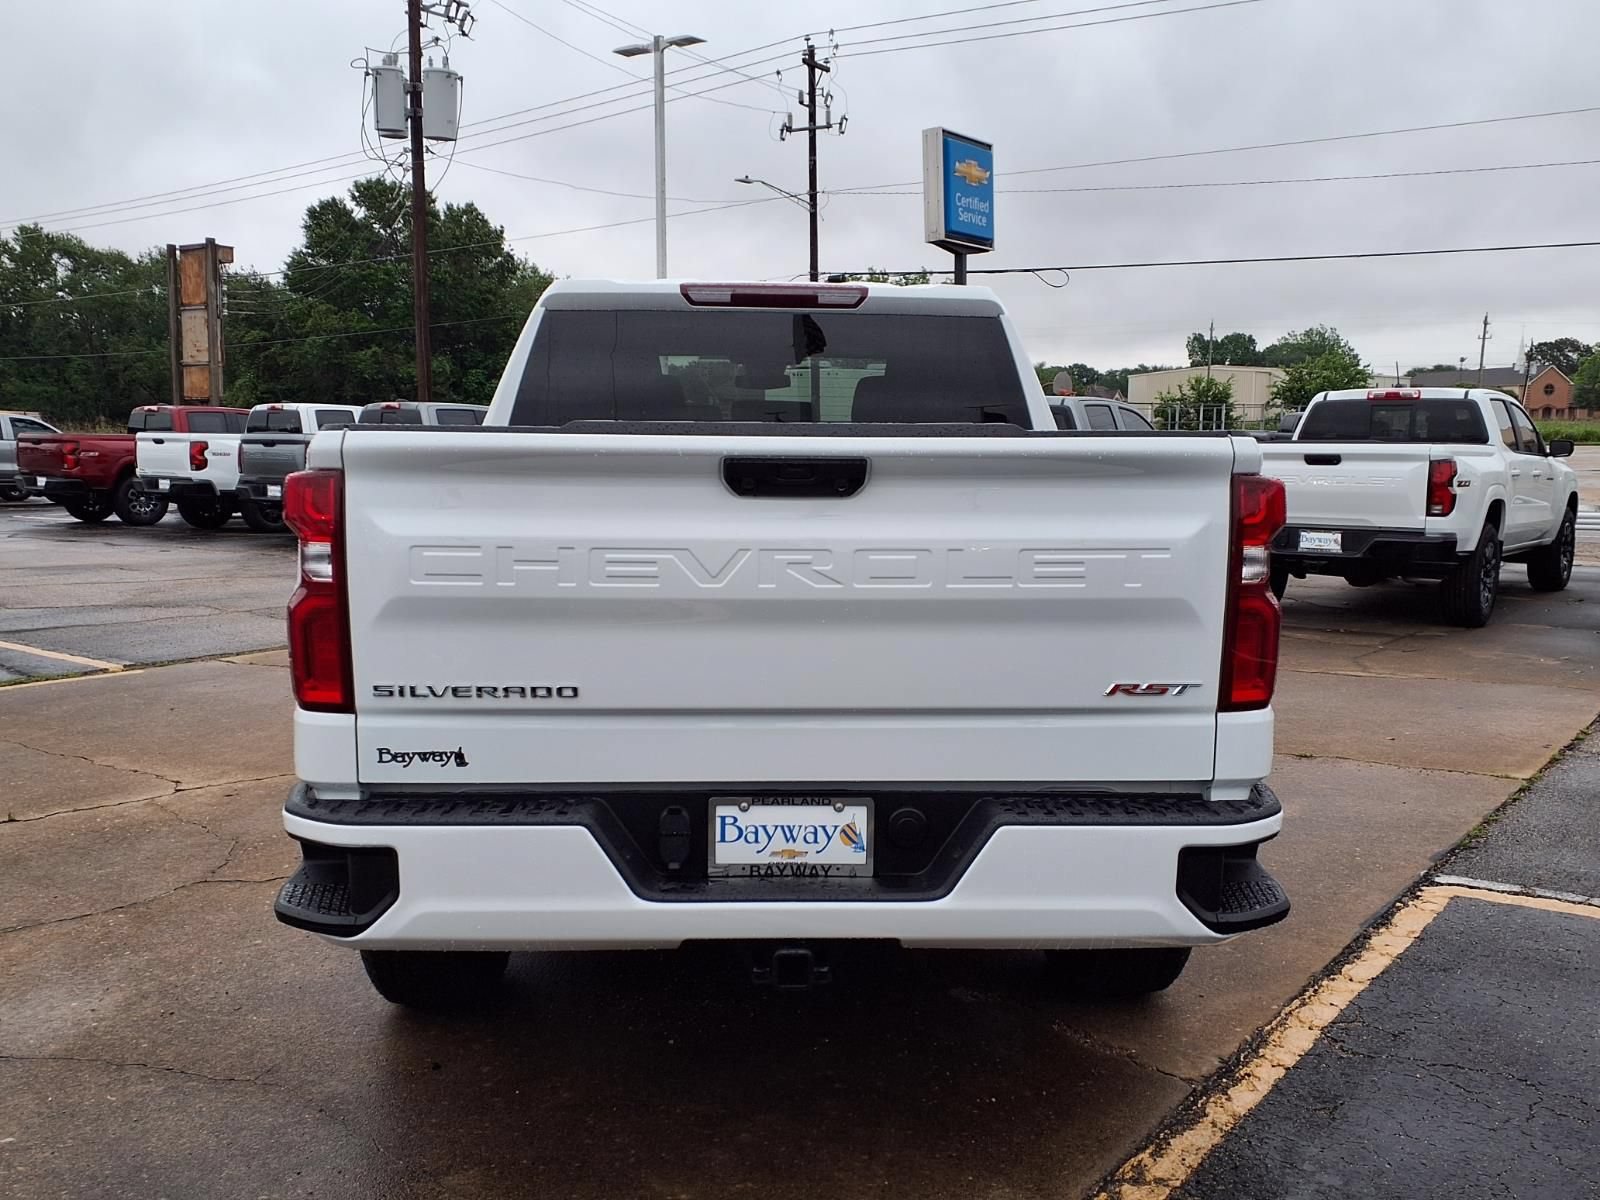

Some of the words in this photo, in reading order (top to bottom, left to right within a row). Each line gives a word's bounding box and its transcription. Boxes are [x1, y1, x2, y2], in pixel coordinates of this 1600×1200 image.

[955, 193, 990, 213] Certified
[958, 208, 988, 227] Service
[1268, 474, 1404, 488] EVROLET
[1301, 534, 1332, 547] Bayway
[409, 545, 1171, 588] CHEVROLET
[372, 685, 579, 699] SILVERADO
[1103, 683, 1202, 697] RST
[376, 747, 456, 768] Bayway
[716, 815, 840, 854] Bayway
[750, 865, 832, 877] BAYWAY
